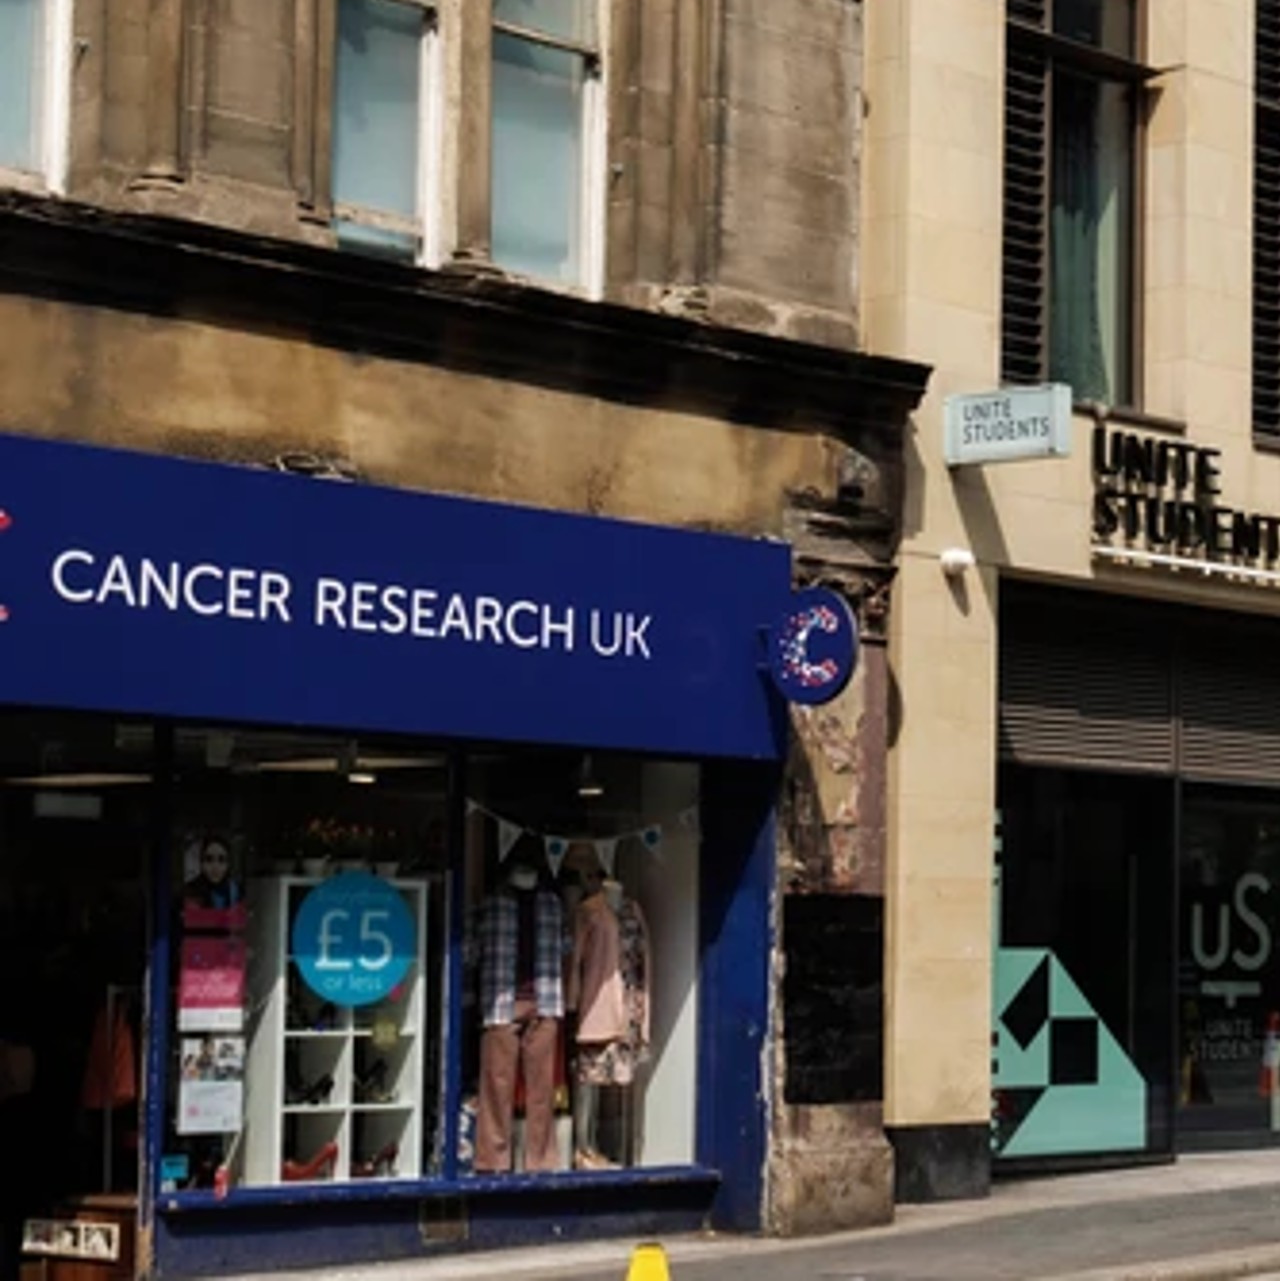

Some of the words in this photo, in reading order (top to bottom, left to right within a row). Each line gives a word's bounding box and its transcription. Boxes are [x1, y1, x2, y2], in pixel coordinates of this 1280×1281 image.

[963, 398, 1011, 421] UNITE
[963, 417, 1050, 444] STUDENTS
[1093, 424, 1222, 496] UNITE
[51, 549, 291, 622] CANCER
[316, 577, 575, 651] RESEARCH
[590, 609, 652, 659] UK
[314, 908, 393, 970] £5
